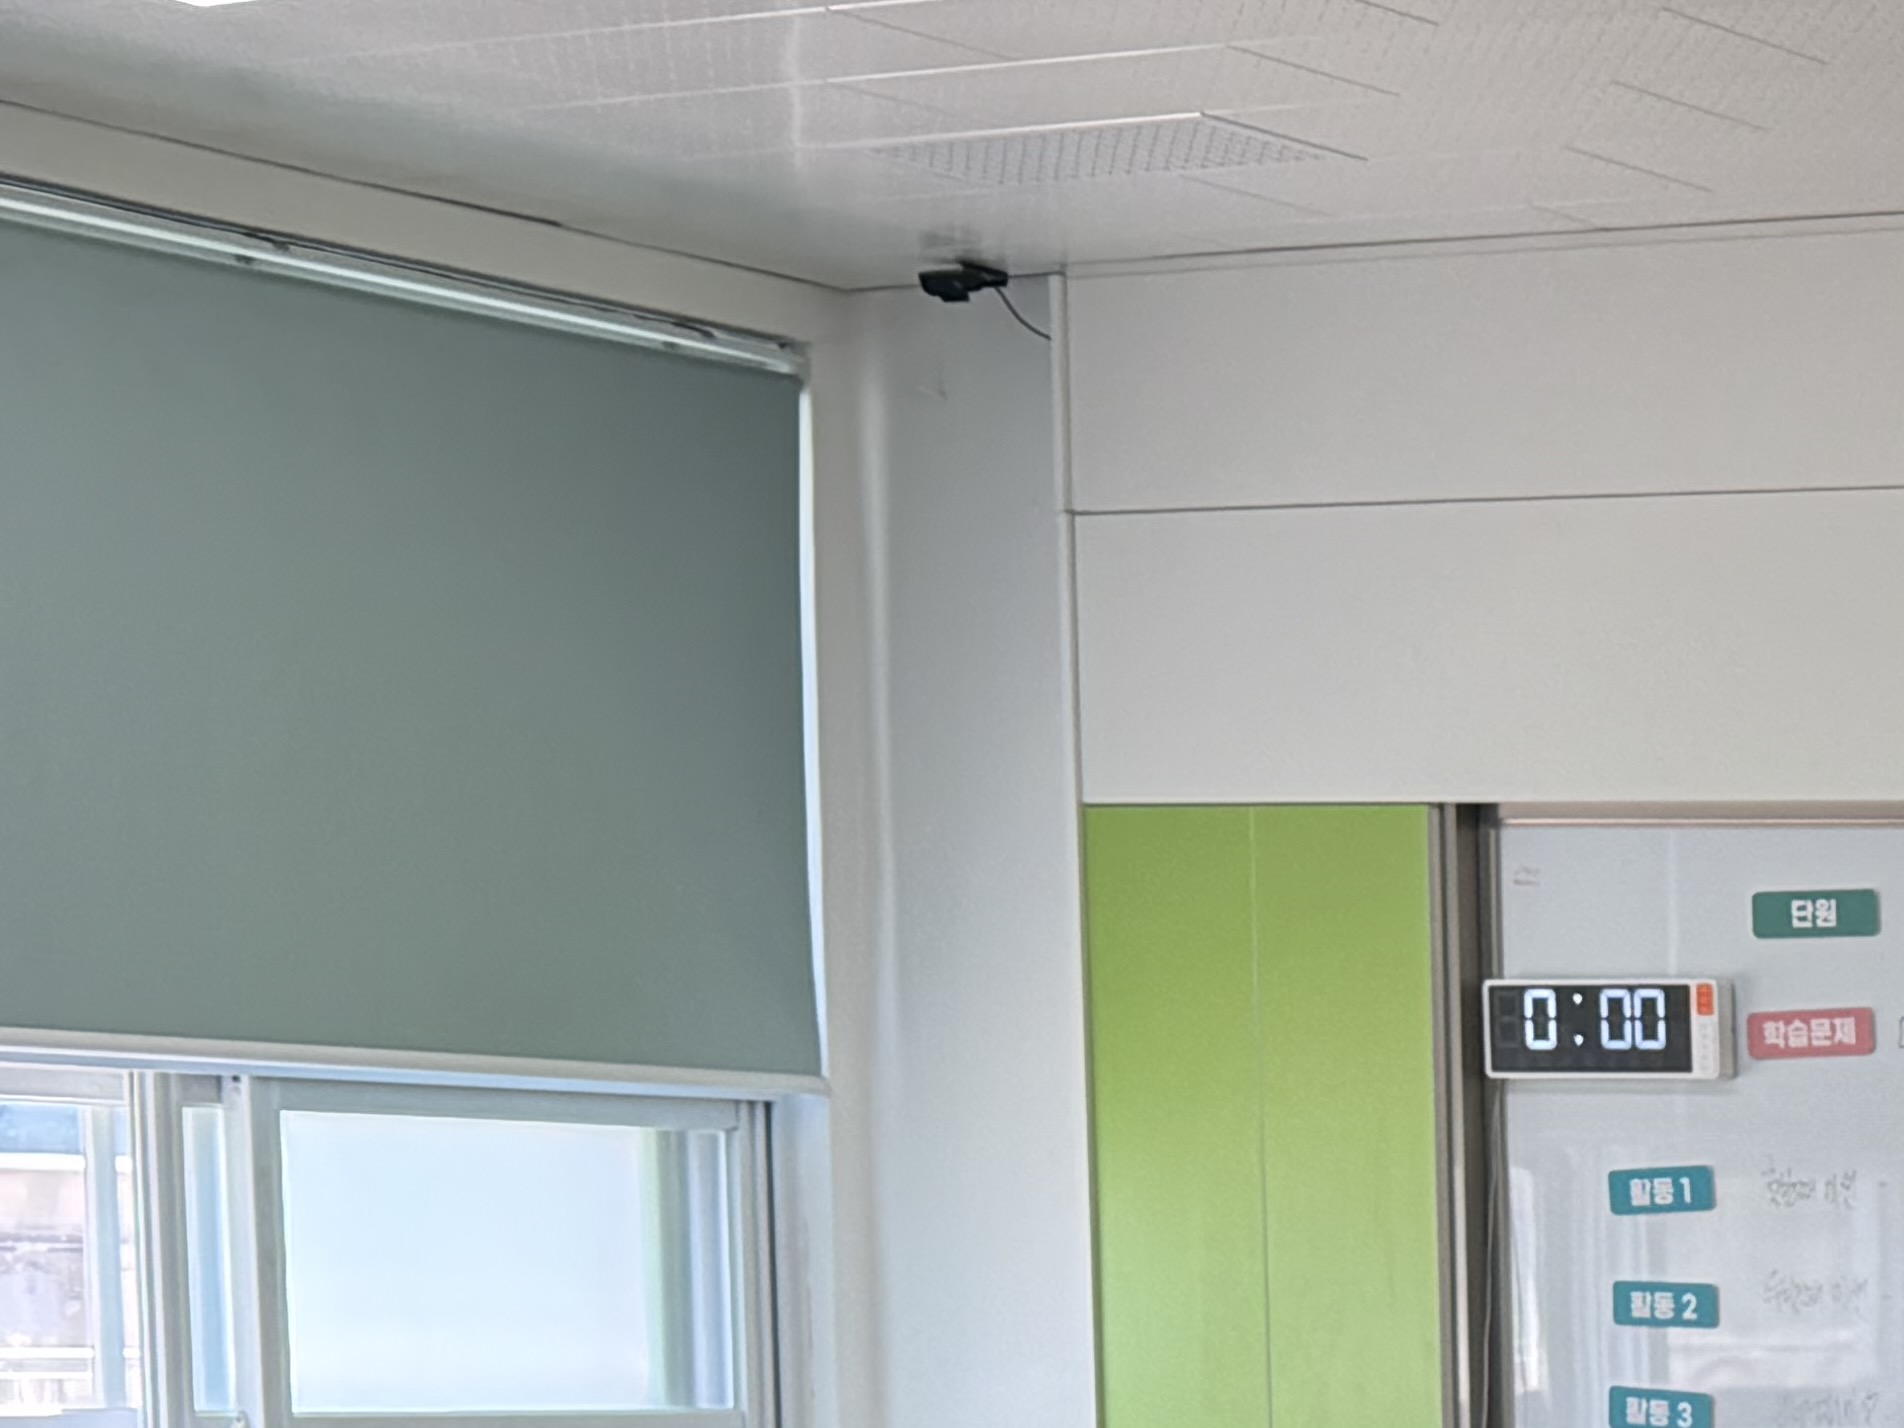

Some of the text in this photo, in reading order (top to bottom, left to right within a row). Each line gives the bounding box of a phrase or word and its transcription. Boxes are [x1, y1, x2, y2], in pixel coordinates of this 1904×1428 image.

[1790, 897, 1838, 929] 단원
[1523, 988, 1666, 1051] 0:00
[1762, 1016, 1856, 1049] 학습문제
[1628, 1175, 1675, 1206] 활동
[1629, 1290, 1676, 1320] 활동
[1625, 1396, 1671, 1427] 활동
